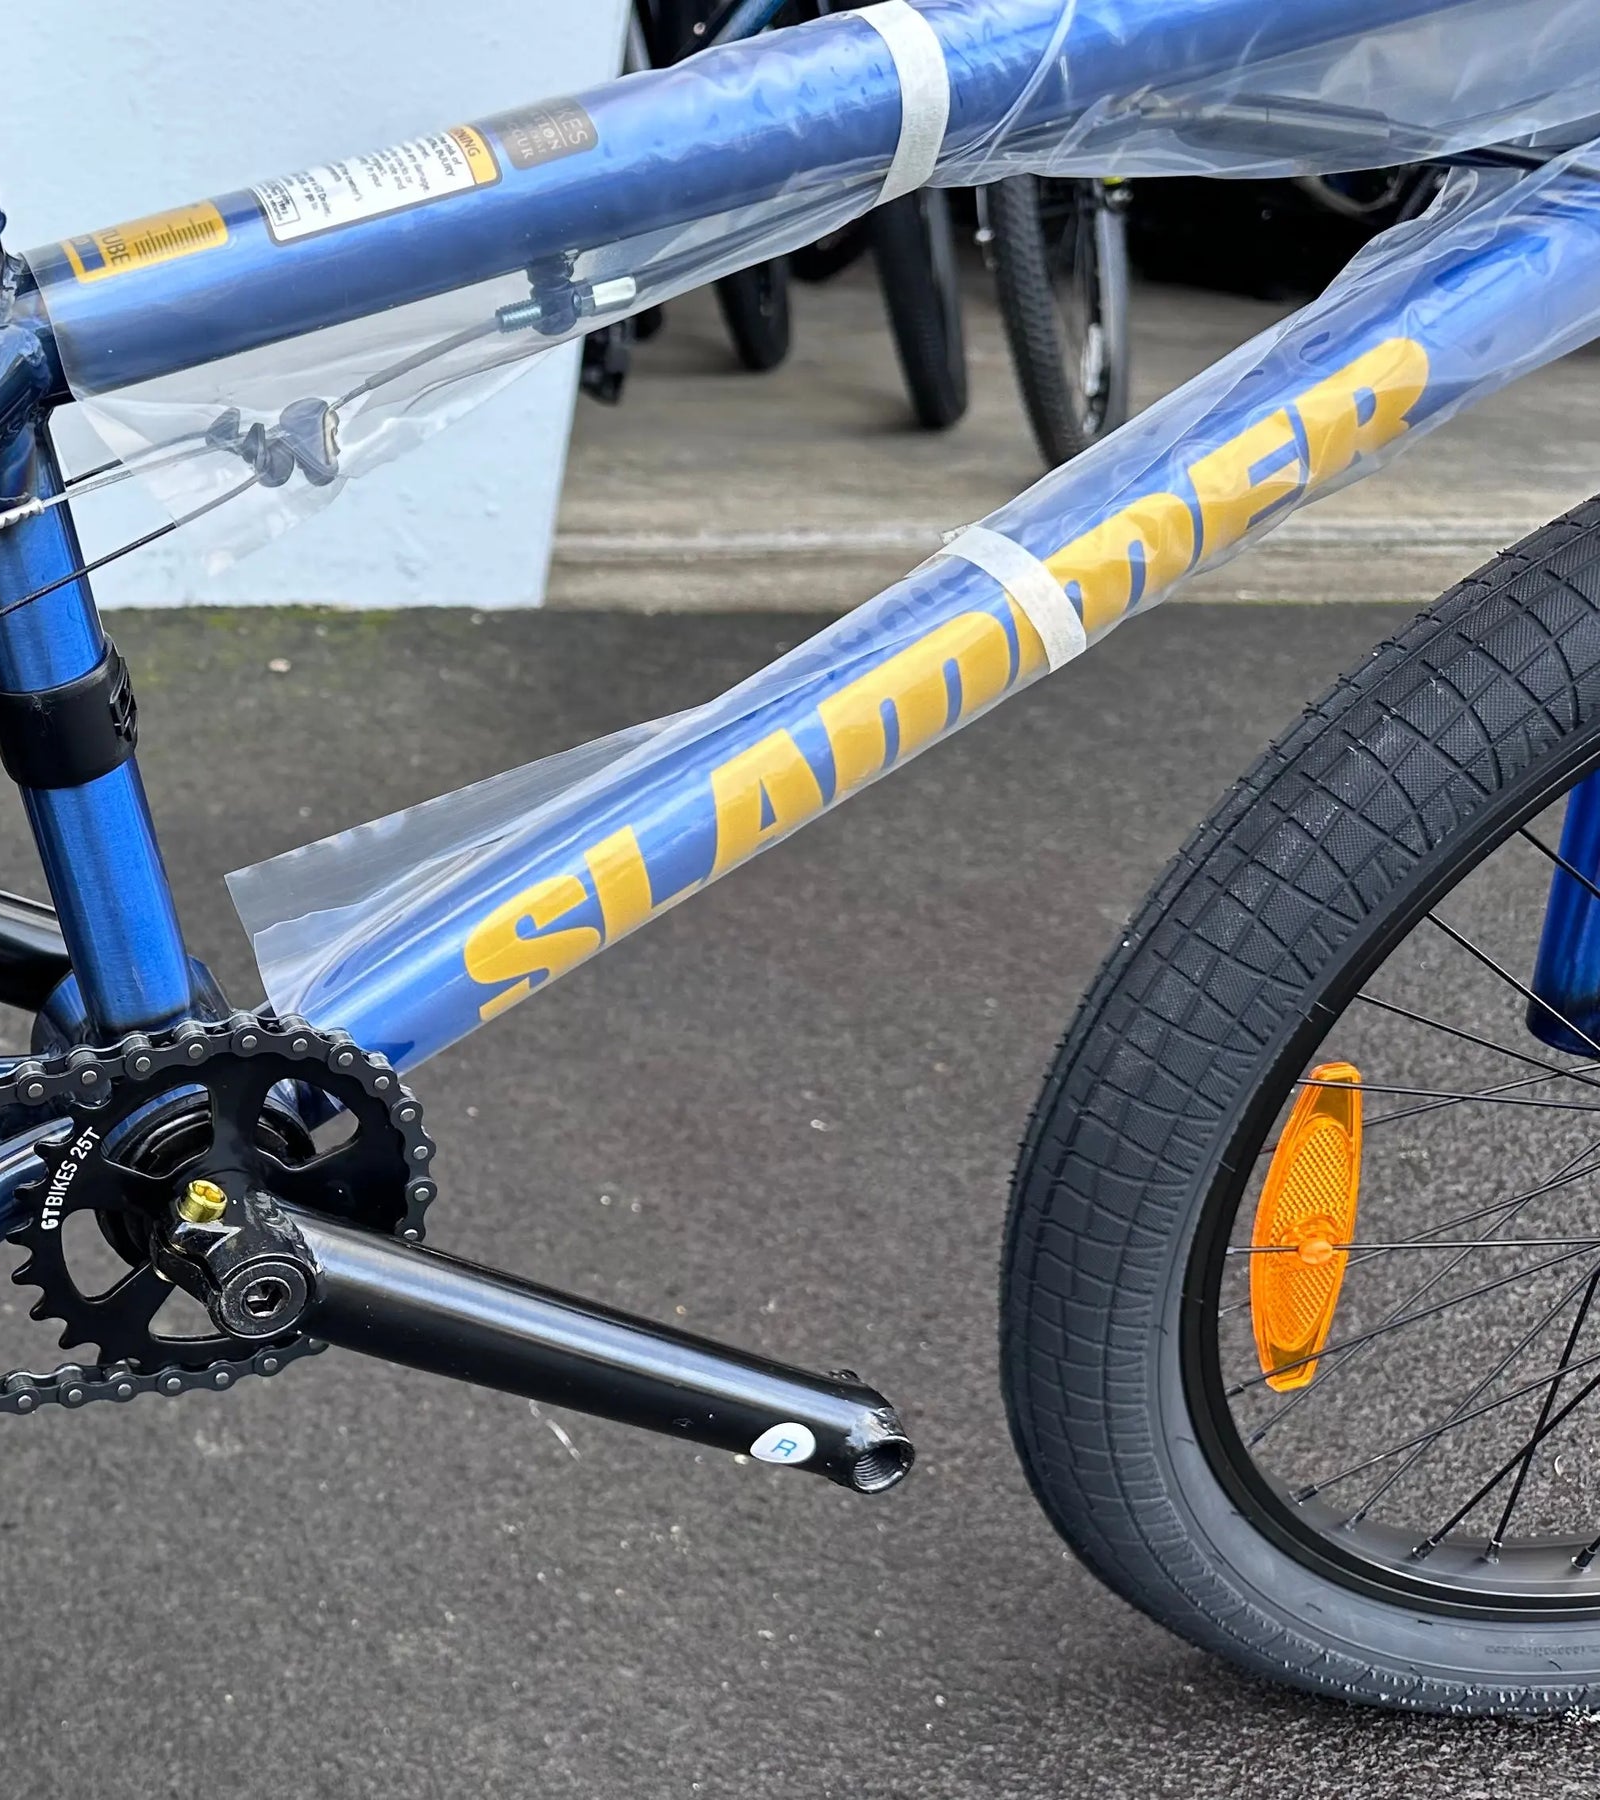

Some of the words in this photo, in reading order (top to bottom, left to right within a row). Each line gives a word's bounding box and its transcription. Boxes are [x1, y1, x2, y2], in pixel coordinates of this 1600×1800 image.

[534, 115, 562, 150] TION
[557, 108, 588, 143] KES
[69, 1126, 100, 1160] 25T
[771, 1439, 797, 1457] R
